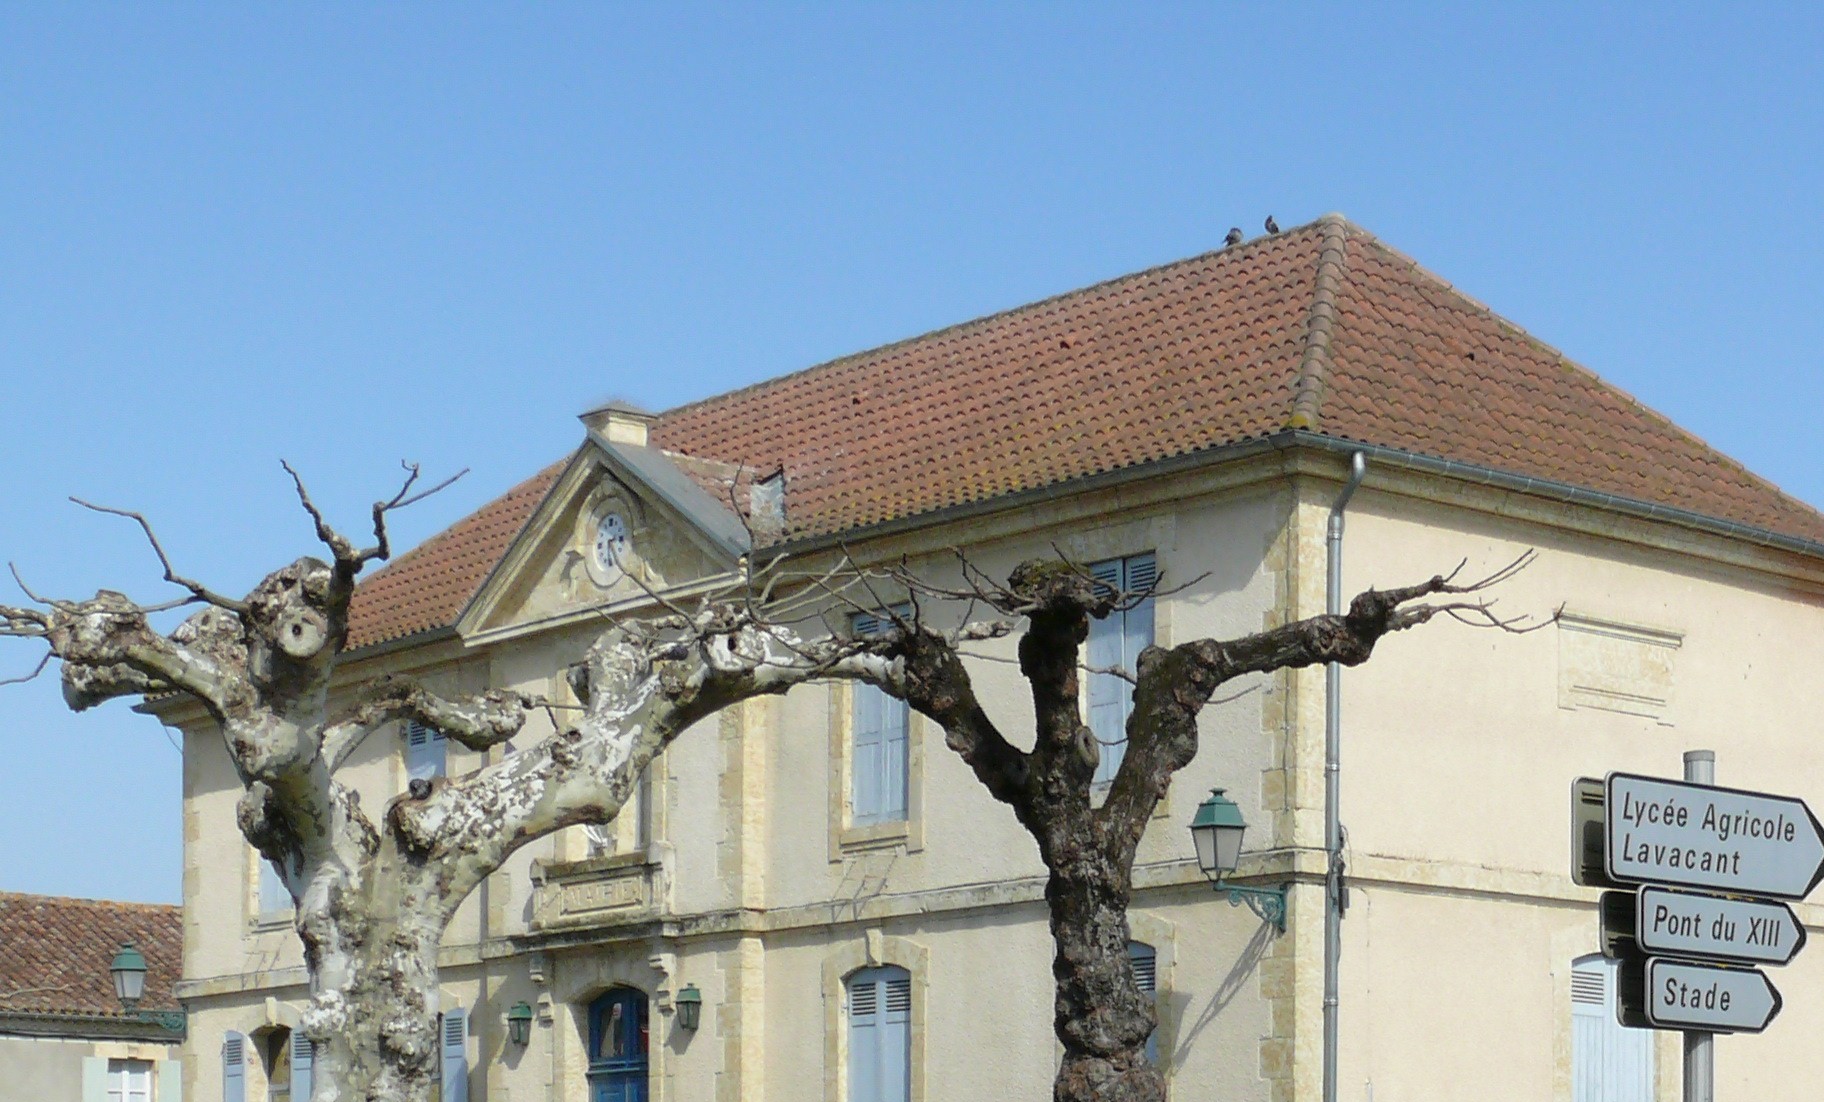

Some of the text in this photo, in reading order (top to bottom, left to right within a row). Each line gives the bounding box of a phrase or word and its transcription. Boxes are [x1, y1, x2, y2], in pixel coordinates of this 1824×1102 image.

[1622, 791, 1796, 842] Lycée Agricole
[1623, 833, 1741, 875] Lavacant
[1653, 905, 1781, 947] Pont du XIII
[1663, 977, 1732, 1012] Stade
